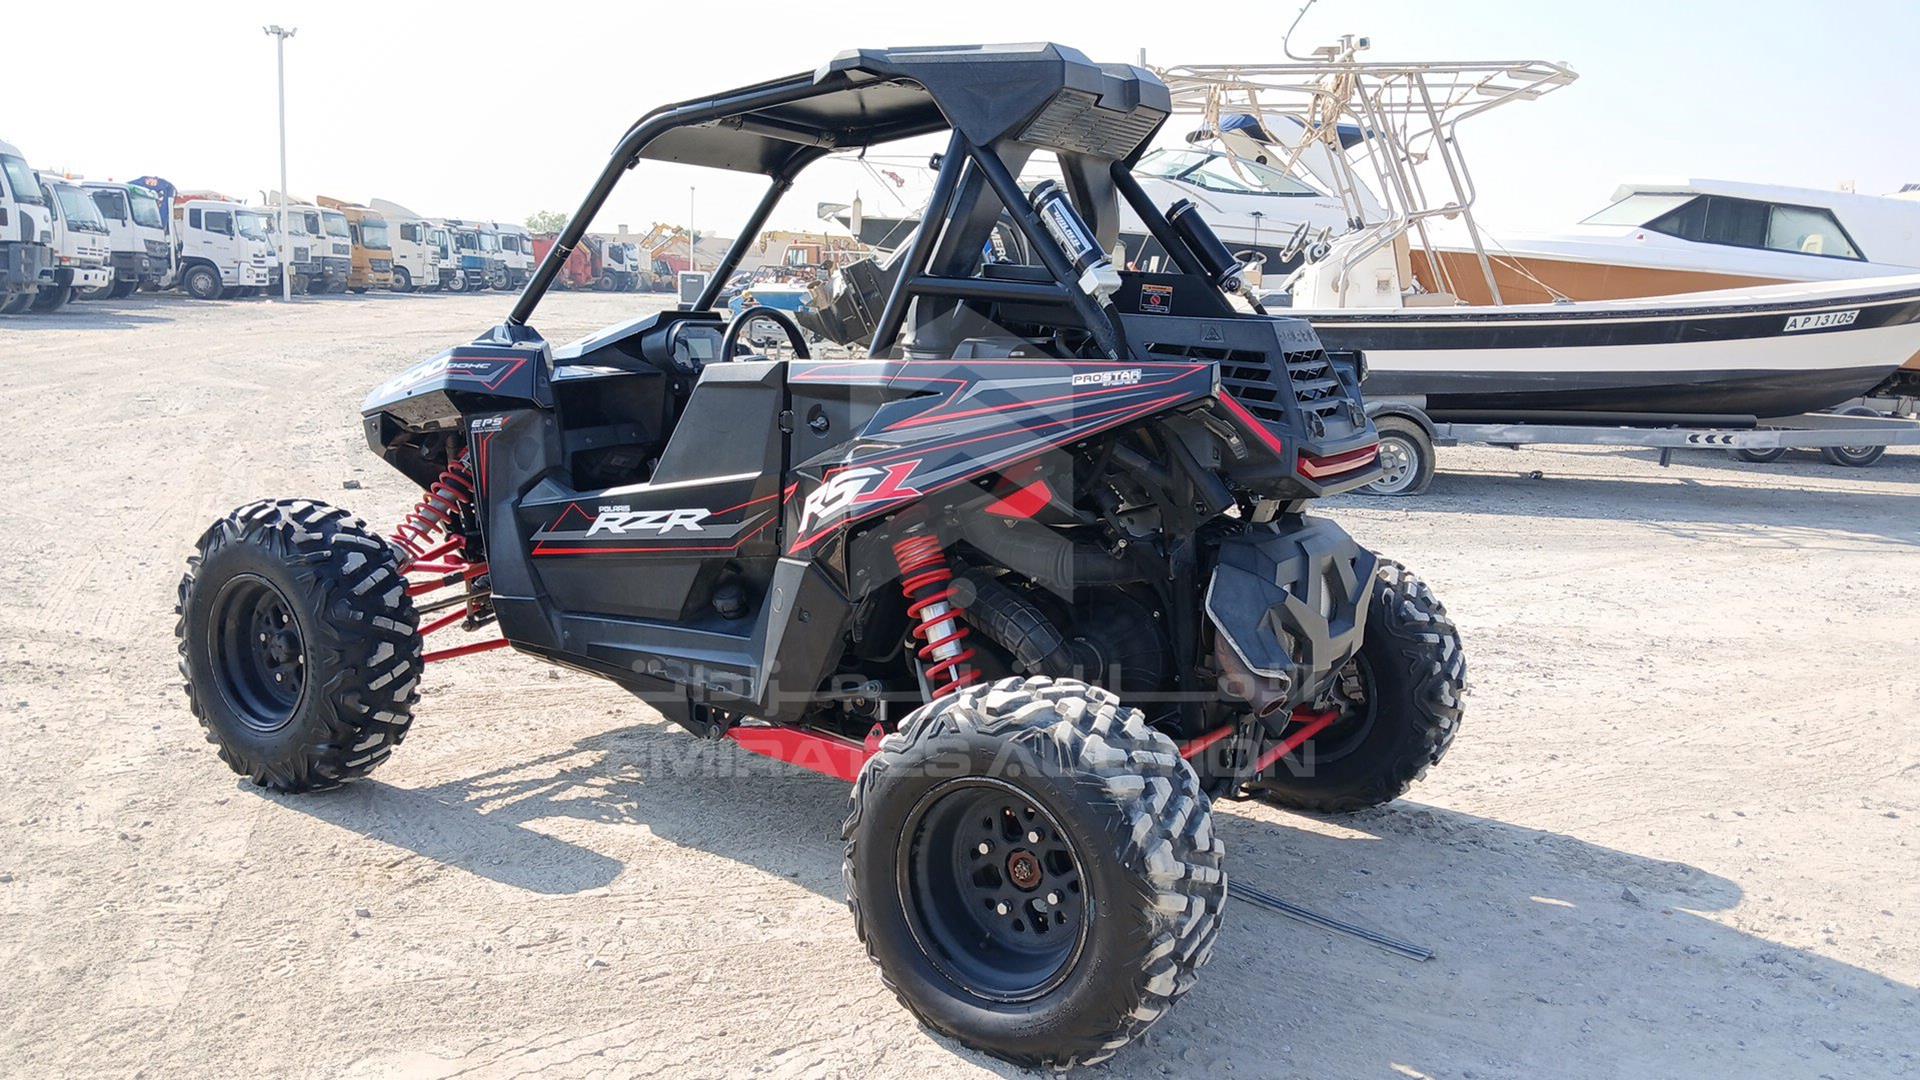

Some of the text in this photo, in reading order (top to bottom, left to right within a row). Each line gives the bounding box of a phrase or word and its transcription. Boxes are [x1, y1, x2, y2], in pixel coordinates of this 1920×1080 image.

[1814, 312, 1856, 327] 13105
[446, 362, 492, 370] DOHC
[471, 417, 504, 428] EPS
[798, 458, 924, 534] RS1
[598, 504, 631, 513] POLARIS
[583, 507, 712, 538] RZR
